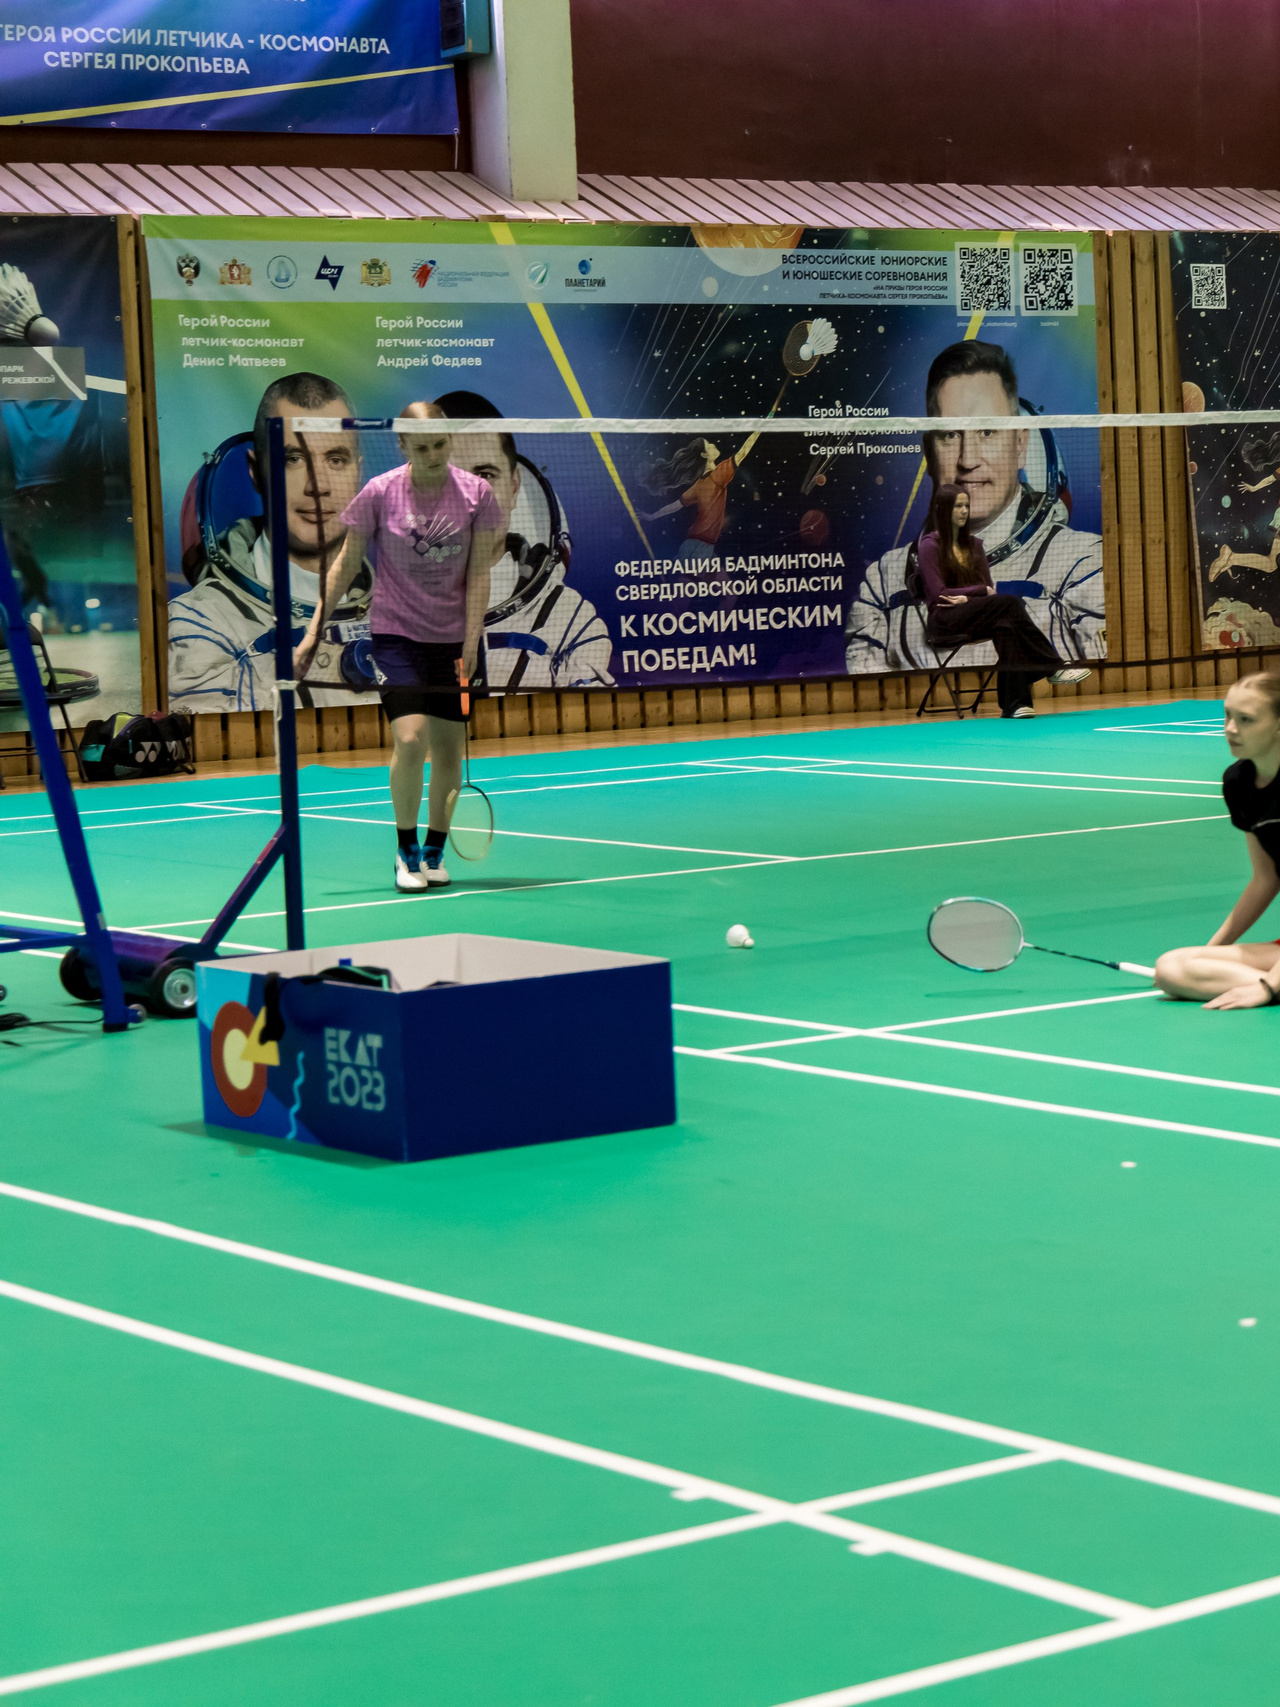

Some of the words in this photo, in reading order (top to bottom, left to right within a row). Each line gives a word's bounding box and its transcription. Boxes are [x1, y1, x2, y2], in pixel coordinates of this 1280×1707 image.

[61, 27, 151, 45] РОССИИ
[155, 30, 244, 49] ЛЕТЧИКА
[260, 34, 390, 54] КОСМОНАВТА
[43, 51, 116, 69] СЕРГЕЯ
[121, 53, 250, 75] ПРОКОПЬЕВА
[782, 253, 875, 265] ВСЕРОССИЙСКИЕ
[881, 256, 948, 266] ЮНИОРСКИЕ
[565, 276, 606, 287] ПЛАНЕТАРИЙ
[782, 270, 790, 280] И
[793, 270, 863, 281] ЮНОШЕСКИЕ
[865, 271, 948, 282] СОРЕВНОВАНИЯ
[179, 314, 218, 329] Герой
[220, 315, 270, 328] России
[375, 316, 413, 331] Герой
[416, 316, 463, 328] России
[181, 337, 304, 348] летчик-космонавт
[376, 338, 495, 348] летчик-космонавт
[182, 353, 225, 368] Денис
[228, 354, 287, 367] Матвеев
[377, 354, 429, 369] Андрей
[431, 354, 483, 368] Федяев
[0, 365, 24, 373] ПАРК
[808, 405, 843, 418] Герой
[845, 405, 889, 417] России
[809, 442, 854, 458] Сергей
[857, 443, 921, 457] Прокопьев
[614, 557, 721, 578] ФЕДЕРАЦИЯ
[725, 552, 845, 574] БАДМИНТОНА
[615, 575, 757, 601] СВЕРДЛОВСКОЙ
[761, 575, 843, 594] ОБЛАСТИ
[620, 615, 638, 637] К
[643, 604, 842, 637] КОСМИЧЕСКИМ
[622, 643, 757, 673] ПОБЕДАМ!
[324, 1026, 383, 1067] EKAT
[327, 1063, 387, 1112] 2023
